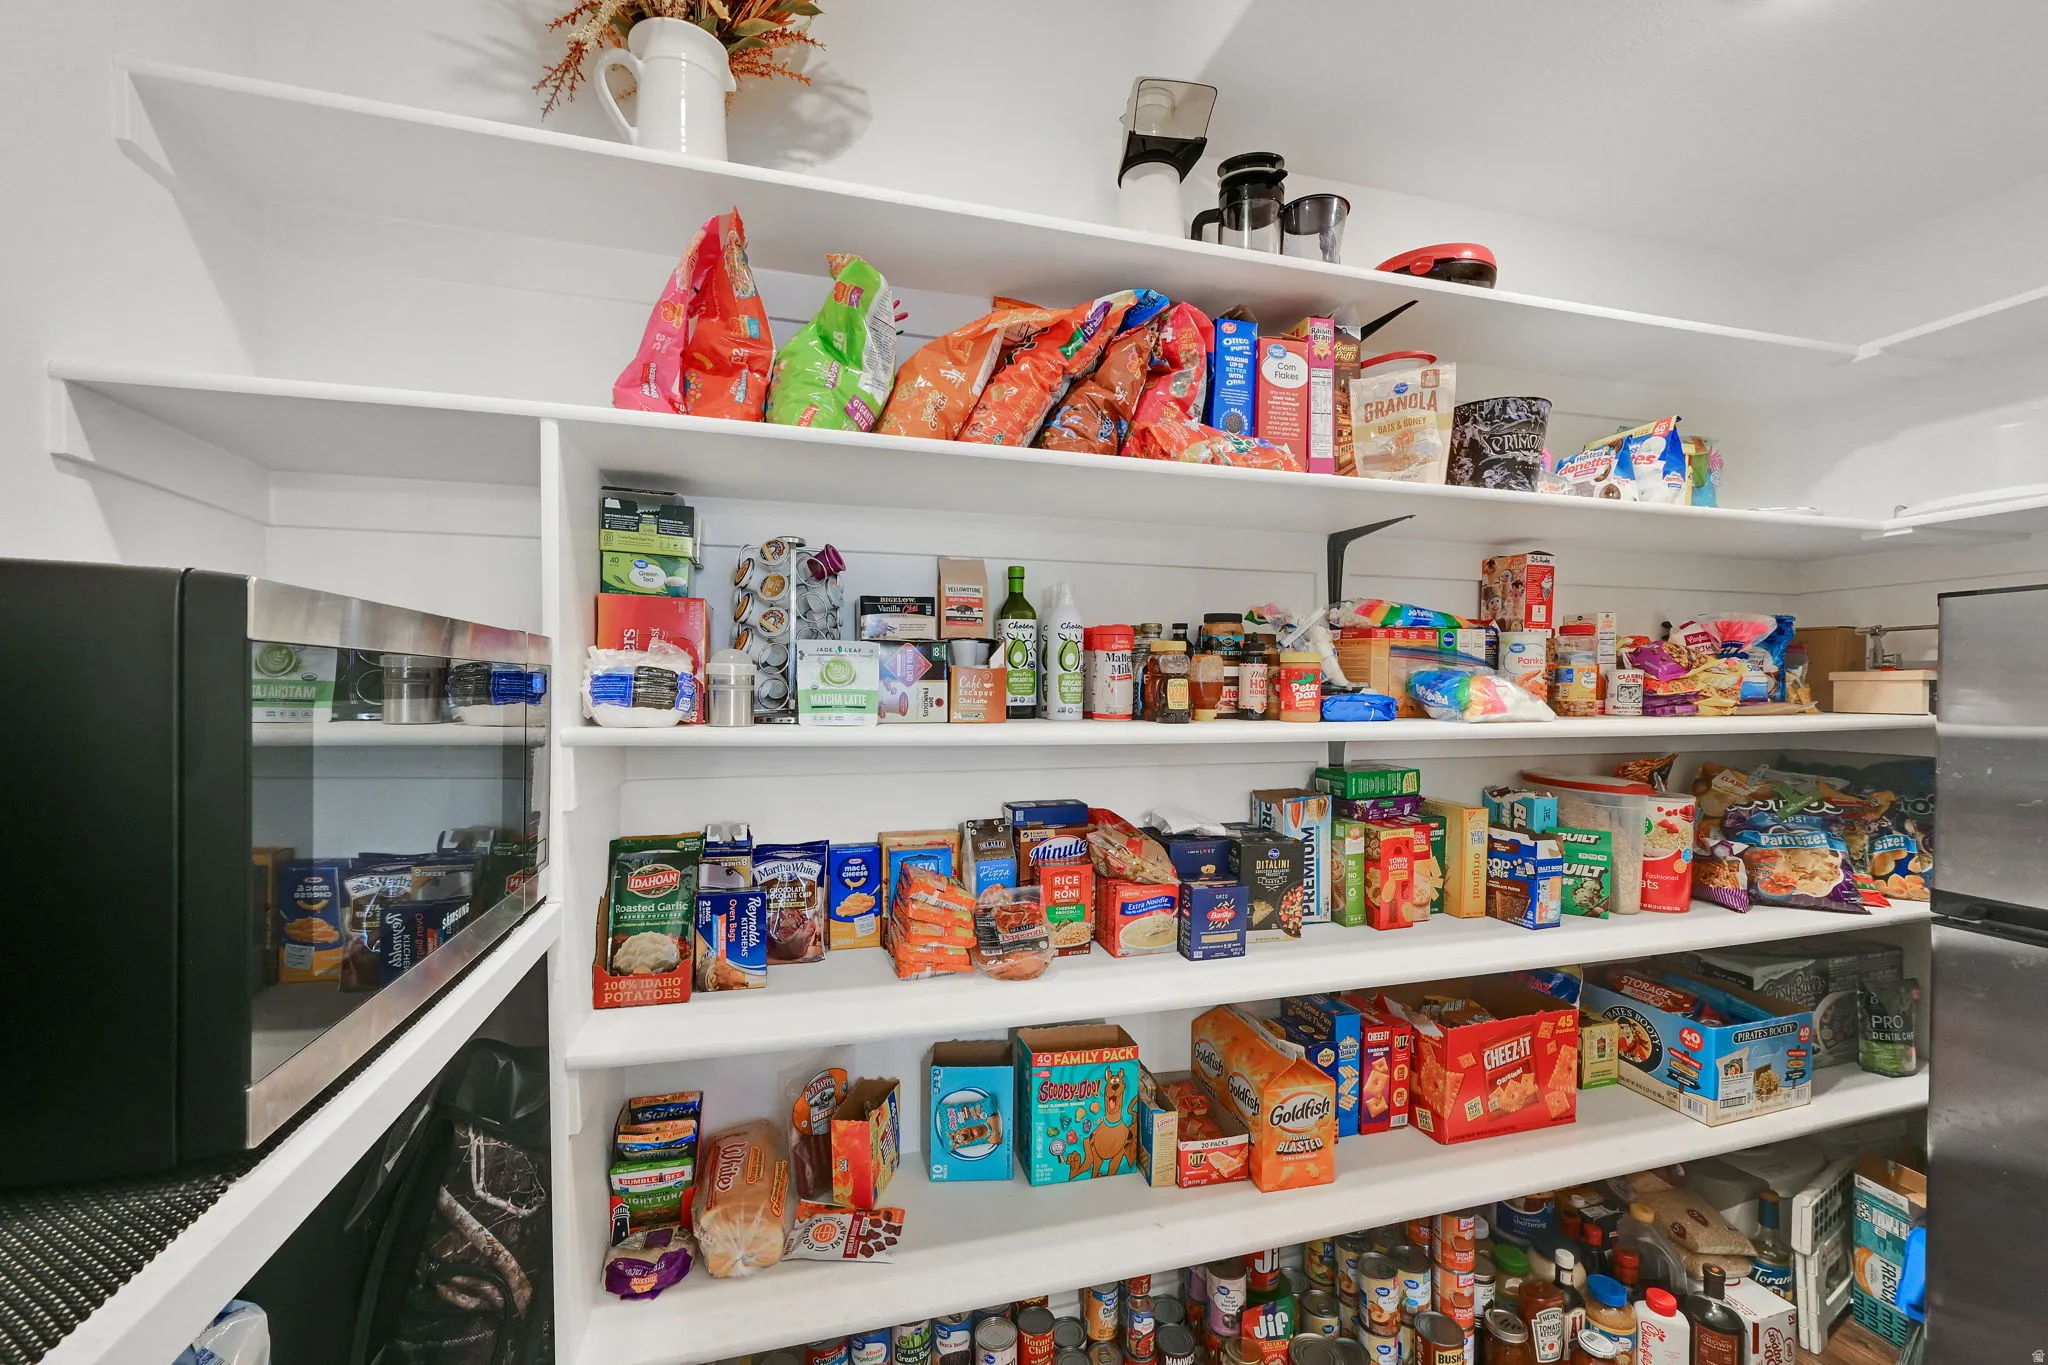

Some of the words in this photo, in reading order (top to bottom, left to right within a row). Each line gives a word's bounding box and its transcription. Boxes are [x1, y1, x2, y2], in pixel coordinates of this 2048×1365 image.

[1311, 327, 1332, 335] Raisin
[1335, 350, 1355, 361] Puffs
[1277, 362, 1297, 371] Corn
[1274, 371, 1299, 380] Flakes
[1364, 390, 1438, 424] GRANOLA
[1378, 423, 1396, 435] OATS
[1404, 416, 1427, 429] HONEY
[1576, 451, 1603, 462] Hostess
[1558, 456, 1615, 477] donettes
[947, 586, 982, 594] YELLOWSTONE
[877, 604, 901, 613] Vanilla
[1008, 621, 1035, 629] Chosen
[1517, 656, 1543, 665] Panko
[1111, 663, 1131, 675] Milk
[959, 689, 993, 697] Escapes
[1291, 682, 1319, 693] Peter
[810, 694, 843, 705] MATCHA
[844, 694, 867, 705] LATTE
[1294, 691, 1317, 702] Pan
[1470, 831, 1486, 840] WHEAT
[1470, 837, 1486, 846] THINS
[1030, 840, 1088, 862] Minute
[1256, 860, 1290, 870] DITALINI
[1387, 863, 1409, 871] HOUSE
[1388, 857, 1408, 865] TOWN
[758, 864, 791, 881] Martha
[792, 862, 817, 876] White
[980, 865, 1012, 878] Pizza
[1302, 826, 1315, 917] PREMIUM
[1472, 852, 1481, 900] original
[1562, 863, 1606, 877] UILT
[1645, 872, 1680, 881] fashioned
[629, 874, 679, 889] IDAHOAN
[1054, 876, 1079, 885] RICE
[1641, 879, 1659, 890] ats
[1054, 890, 1079, 899] RONI
[615, 903, 656, 914] Roasted
[657, 901, 688, 912] Garlic
[729, 898, 737, 922] Oven
[1127, 902, 1145, 911] Extra
[1145, 897, 1169, 906] Noodle
[441, 902, 471, 930] SAMSUNG
[746, 896, 761, 948] Reynolds
[1210, 911, 1233, 920] Barilla
[727, 923, 737, 943] Bags
[1001, 928, 1045, 941] Pepperoni
[603, 980, 637, 992] 100%
[640, 978, 681, 989] IDAHO
[1620, 975, 1672, 999] STORAGE
[603, 988, 681, 1003] POTATOES
[1557, 1015, 1574, 1028] 45
[1871, 1014, 1904, 1029] PRO
[1367, 1030, 1390, 1042] CHEEZ-IT
[1682, 1029, 1701, 1043] 40
[1737, 1027, 1768, 1042] PIRATE'S
[1768, 1023, 1795, 1038] BOOTY
[1872, 1032, 1899, 1041] DENTAL
[1394, 1034, 1409, 1049] RITZ
[1684, 1040, 1699, 1049] BAGS
[1036, 1054, 1052, 1064] 40
[1054, 1052, 1099, 1066] FAMILY
[1102, 1047, 1135, 1061] PACK
[1483, 1035, 1532, 1070] CHEEZ-IT
[1193, 1042, 1224, 1077] Goldfish
[1038, 1080, 1101, 1103] SCOOBY-DOO!
[1227, 1074, 1260, 1117] Goldfish
[644, 1107, 694, 1121] StarKist
[1269, 1096, 1331, 1127] Goldfish
[1210, 1139, 1229, 1147] PACKS
[1289, 1134, 1311, 1142] FLAVOR
[1276, 1137, 1324, 1155] BLASTED
[706, 1141, 748, 1192] White
[1188, 1153, 1207, 1168] RITZ
[932, 1164, 943, 1179] 10
[621, 1176, 657, 1186] BUMBLE
[665, 1173, 682, 1181] BEE
[624, 1196, 652, 1205] LIGHT
[803, 1217, 823, 1250] GOLDEN
[1753, 1267, 1792, 1285] Toran
[1542, 1311, 1561, 1322] HEINZ
[1253, 1312, 1289, 1339] Jif
[1538, 1322, 1561, 1333] TOMATO
[1540, 1329, 1560, 1338] KETCHUP
[1700, 1334, 1733, 1349] CROWN
[866, 1347, 884, 1356] Mixed
[896, 1351, 917, 1362] Green
